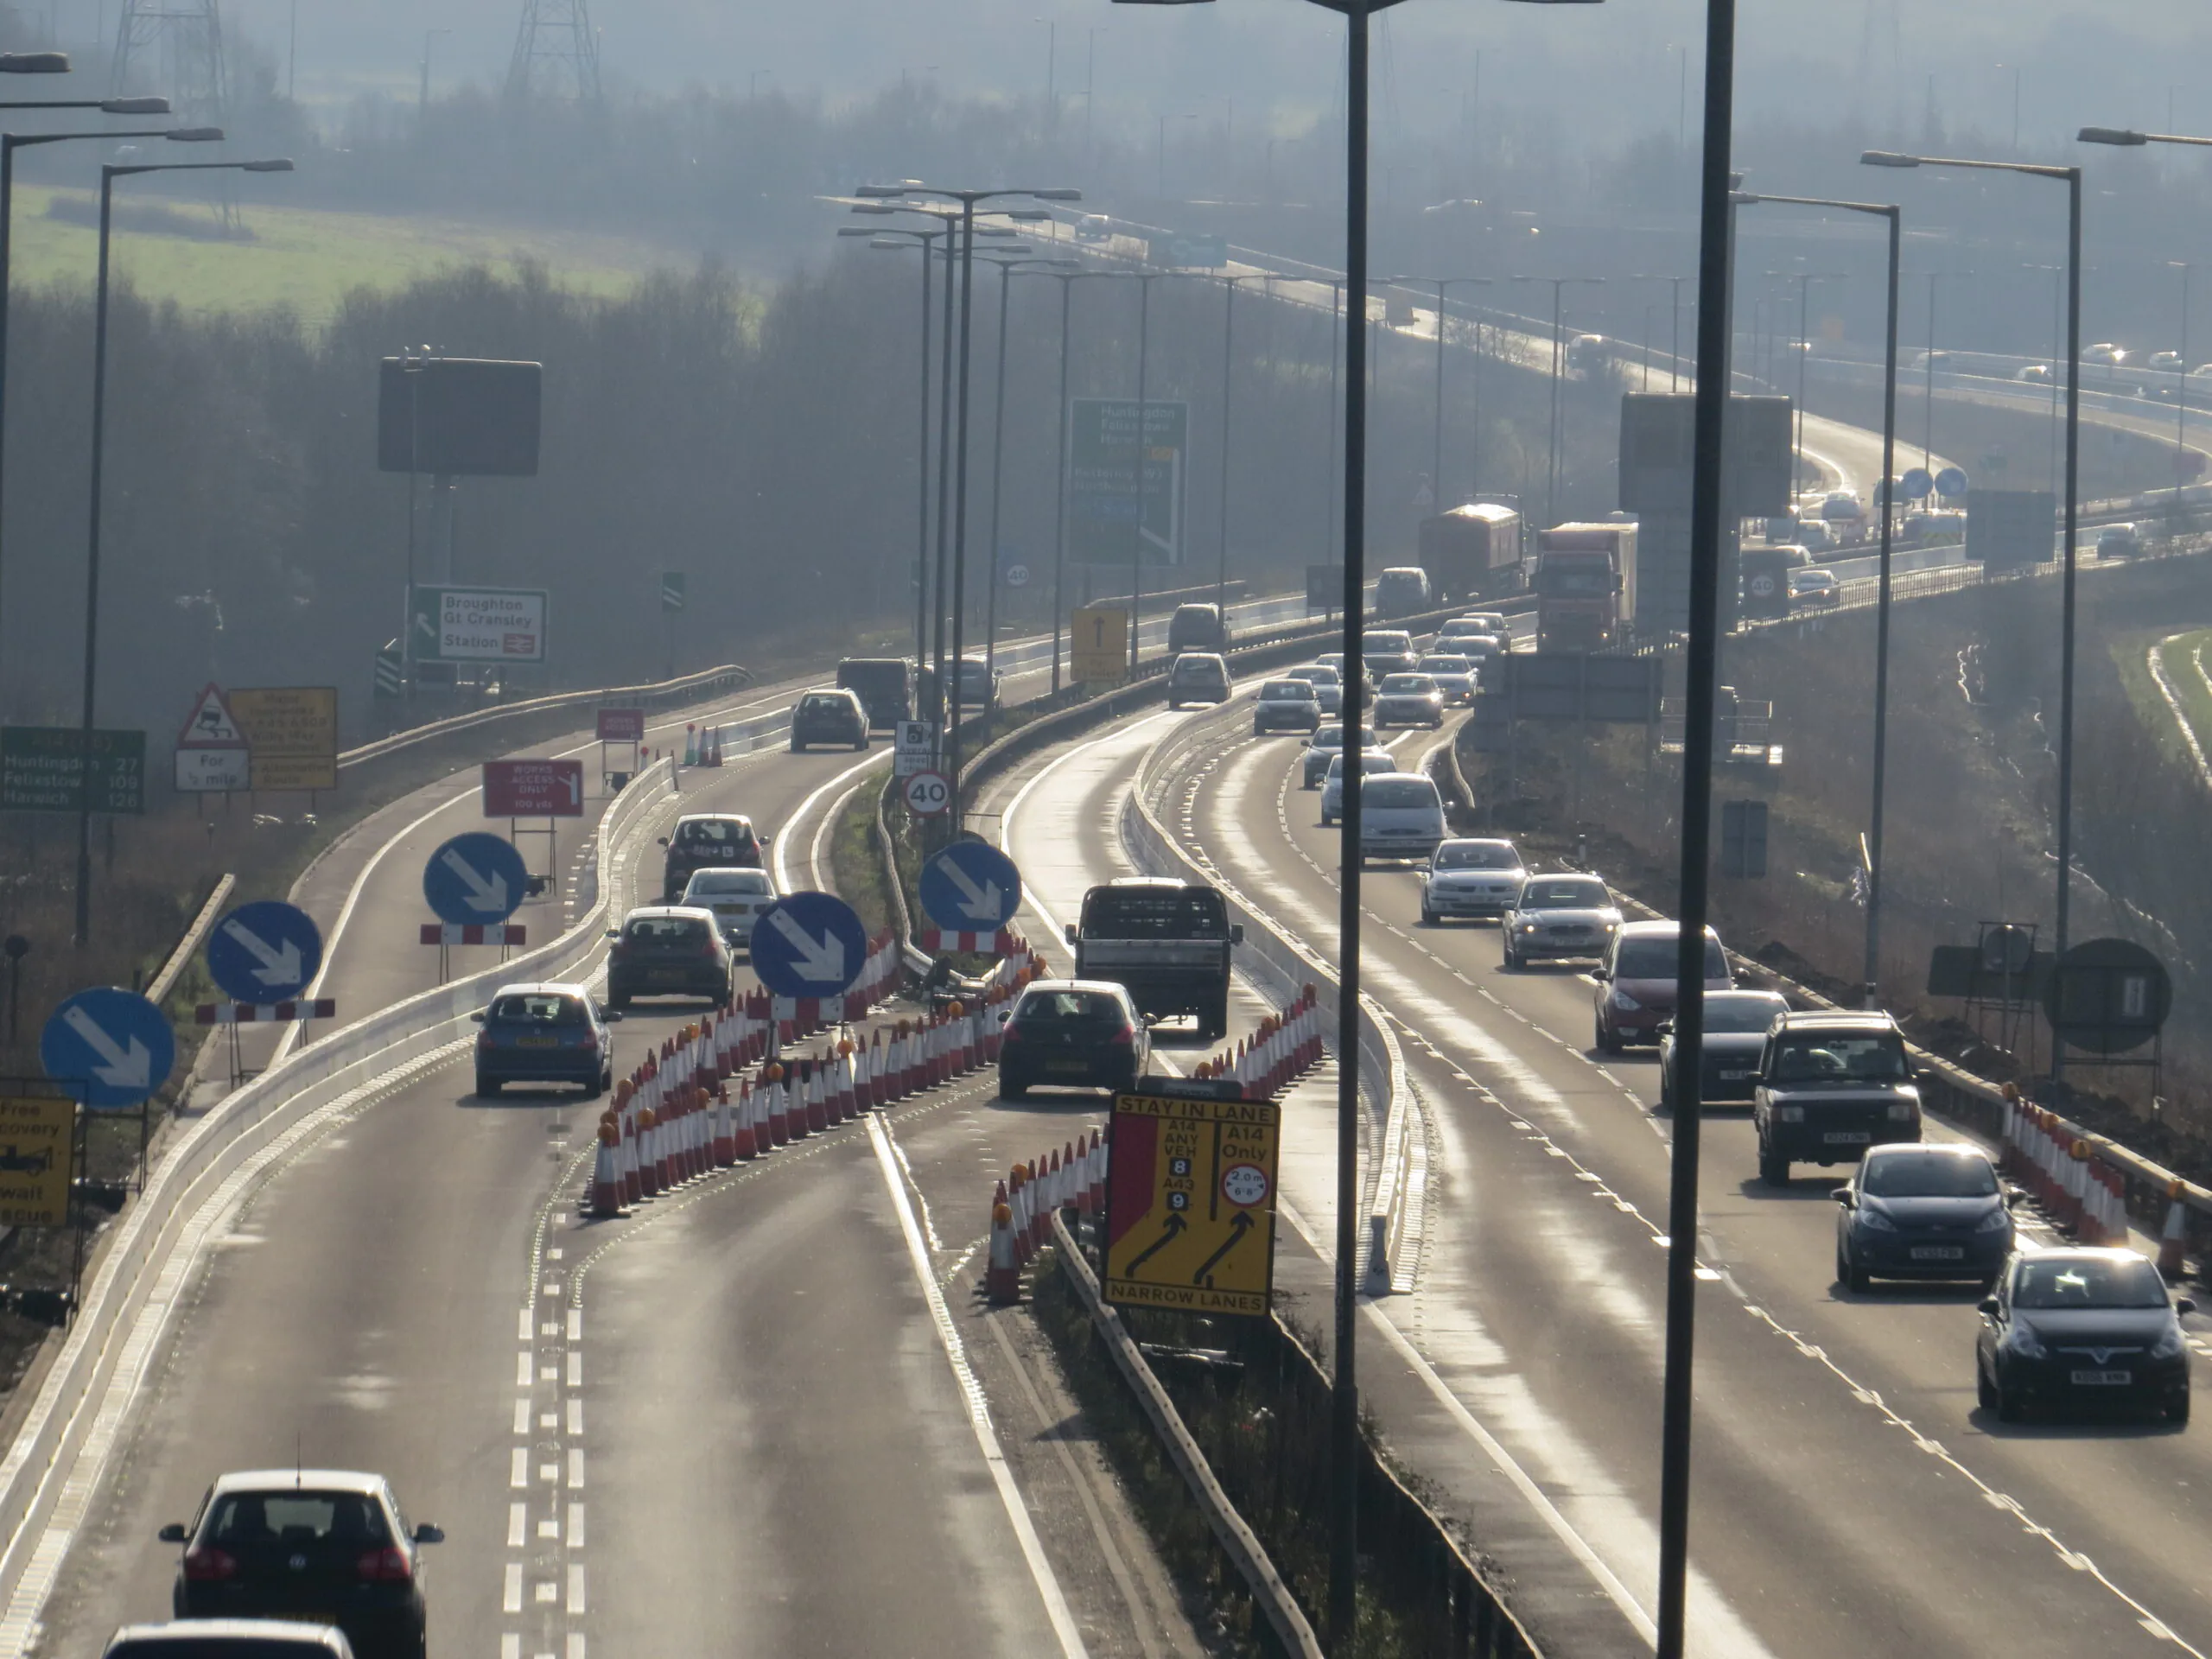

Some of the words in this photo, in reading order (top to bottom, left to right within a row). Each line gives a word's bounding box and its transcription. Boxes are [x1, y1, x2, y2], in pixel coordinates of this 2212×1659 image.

[1009, 570, 1027, 582] 40
[1754, 581, 1773, 591] 40
[446, 596, 523, 611] Broughton
[444, 612, 462, 624] Gt
[467, 613, 532, 629] Cransley
[444, 633, 498, 648] Station
[4, 754, 100, 772] Huntingdn
[116, 758, 138, 772] 27
[200, 754, 225, 768] For
[513, 765, 553, 774] WORKS
[4, 771, 84, 788] Felixstow
[109, 775, 138, 790] 109
[206, 773, 238, 785] mile
[512, 775, 556, 784] ACCESS
[518, 785, 548, 794] ONLY
[910, 783, 946, 803] 40
[4, 790, 69, 805] Harwich
[109, 792, 137, 807] 126
[515, 800, 533, 809] 100
[536, 799, 553, 809] yds
[1, 1102, 41, 1116] Free
[1120, 1097, 1174, 1116] STAY
[1181, 1103, 1205, 1118] IN
[1214, 1104, 1270, 1122] LANE
[1168, 1120, 1197, 1132] A14
[1165, 1133, 1198, 1146] ANY
[1227, 1127, 1264, 1141] A14
[1165, 1145, 1197, 1157] VEH
[1223, 1145, 1267, 1161] Only
[1174, 1160, 1186, 1174] 8
[1163, 1178, 1194, 1191] A43
[1172, 1194, 1184, 1209] 9
[1111, 1285, 1193, 1305] NARROW
[1201, 1291, 1261, 1310] LANES
